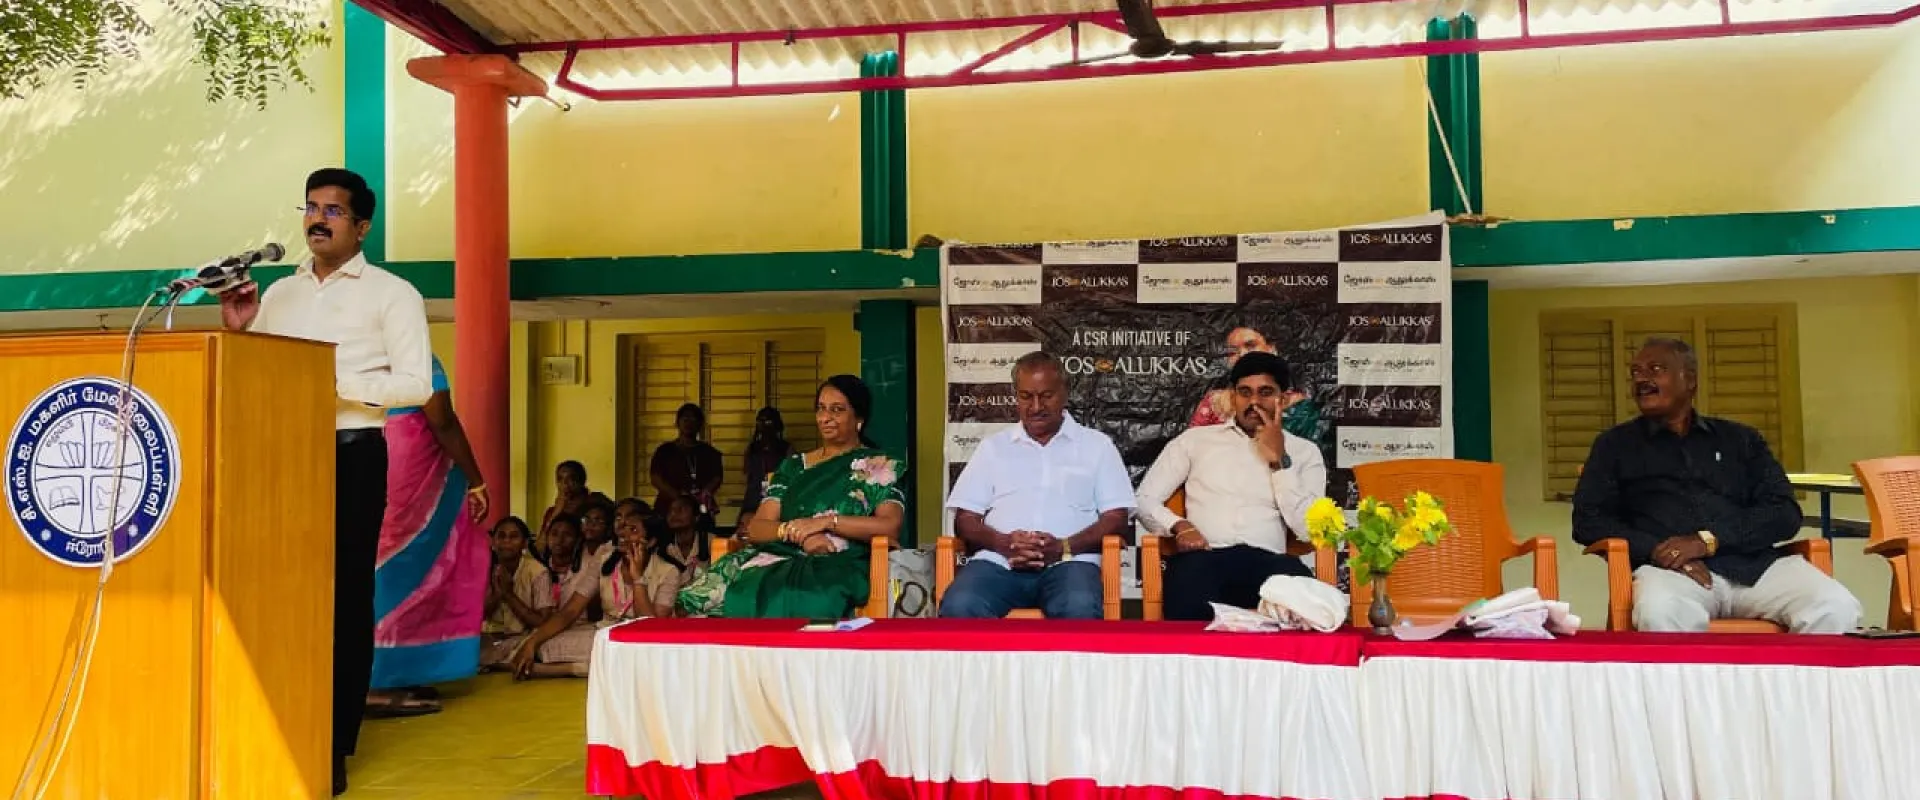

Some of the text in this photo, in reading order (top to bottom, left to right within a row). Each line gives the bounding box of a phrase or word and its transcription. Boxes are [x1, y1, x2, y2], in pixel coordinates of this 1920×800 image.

[1350, 232, 1433, 244] JOS ALUKKAS
[1051, 275, 1129, 288] JOS ALUKKAS
[1247, 275, 1329, 286] JOS ALUKKAS
[958, 316, 977, 328] JOS
[1348, 315, 1433, 327] JOS ALUKKAS
[1072, 330, 1192, 346] A CSR INITIATIVE OF
[1114, 356, 1207, 375] ALUKKAS
[1349, 398, 1369, 409] JOS
[27, 388, 78, 436] மகளிர்
